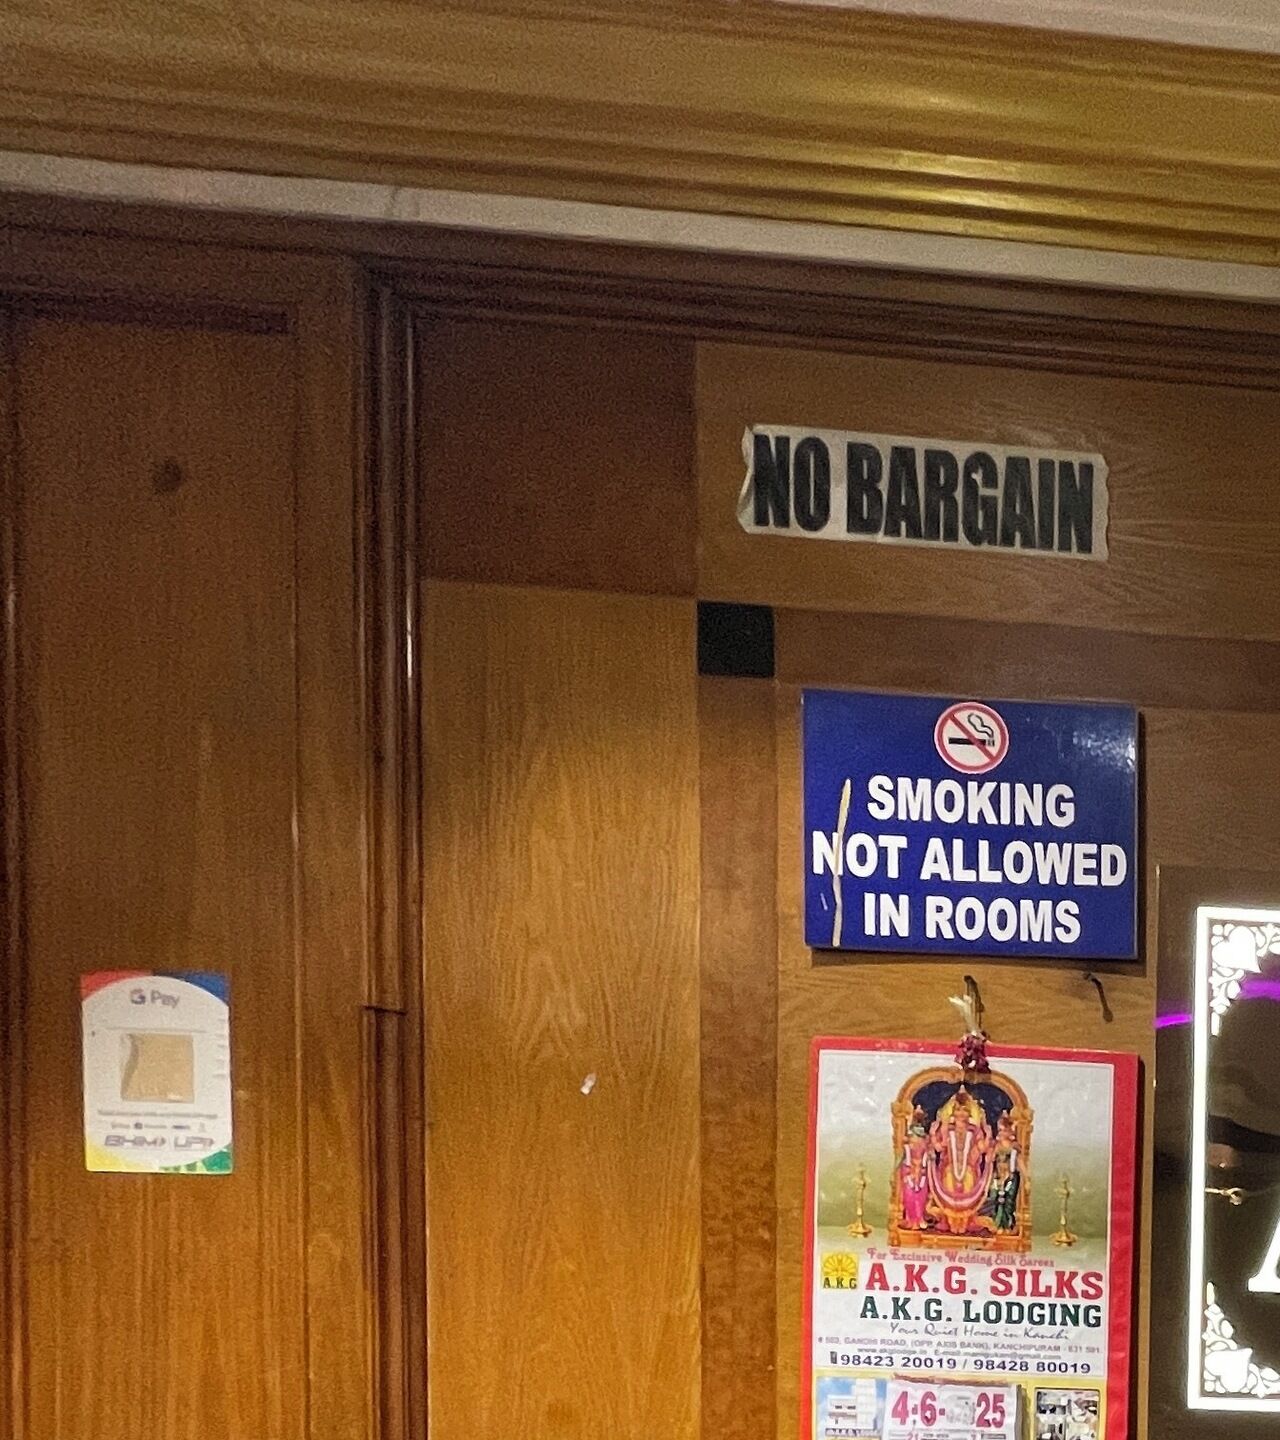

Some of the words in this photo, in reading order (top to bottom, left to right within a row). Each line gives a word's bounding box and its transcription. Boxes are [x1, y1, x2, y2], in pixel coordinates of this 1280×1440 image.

[753, 433, 831, 532] NO
[846, 440, 1094, 554] BARGAIN
[866, 774, 1076, 828] SMOKING
[812, 831, 908, 878] NOT
[919, 837, 1128, 887] ALLOWED
[863, 891, 910, 938] IN
[924, 895, 1082, 944] ROOMS
[865, 1262, 978, 1295] A.K.G.
[989, 1267, 1104, 1301] SILKS
[859, 1295, 953, 1323] A.K.G.
[962, 1299, 1102, 1328] LODGING
[840, 1353, 894, 1368] 98423
[901, 1356, 957, 1370] 20019
[973, 1359, 1030, 1372] 98428
[1036, 1361, 1091, 1374] 80019
